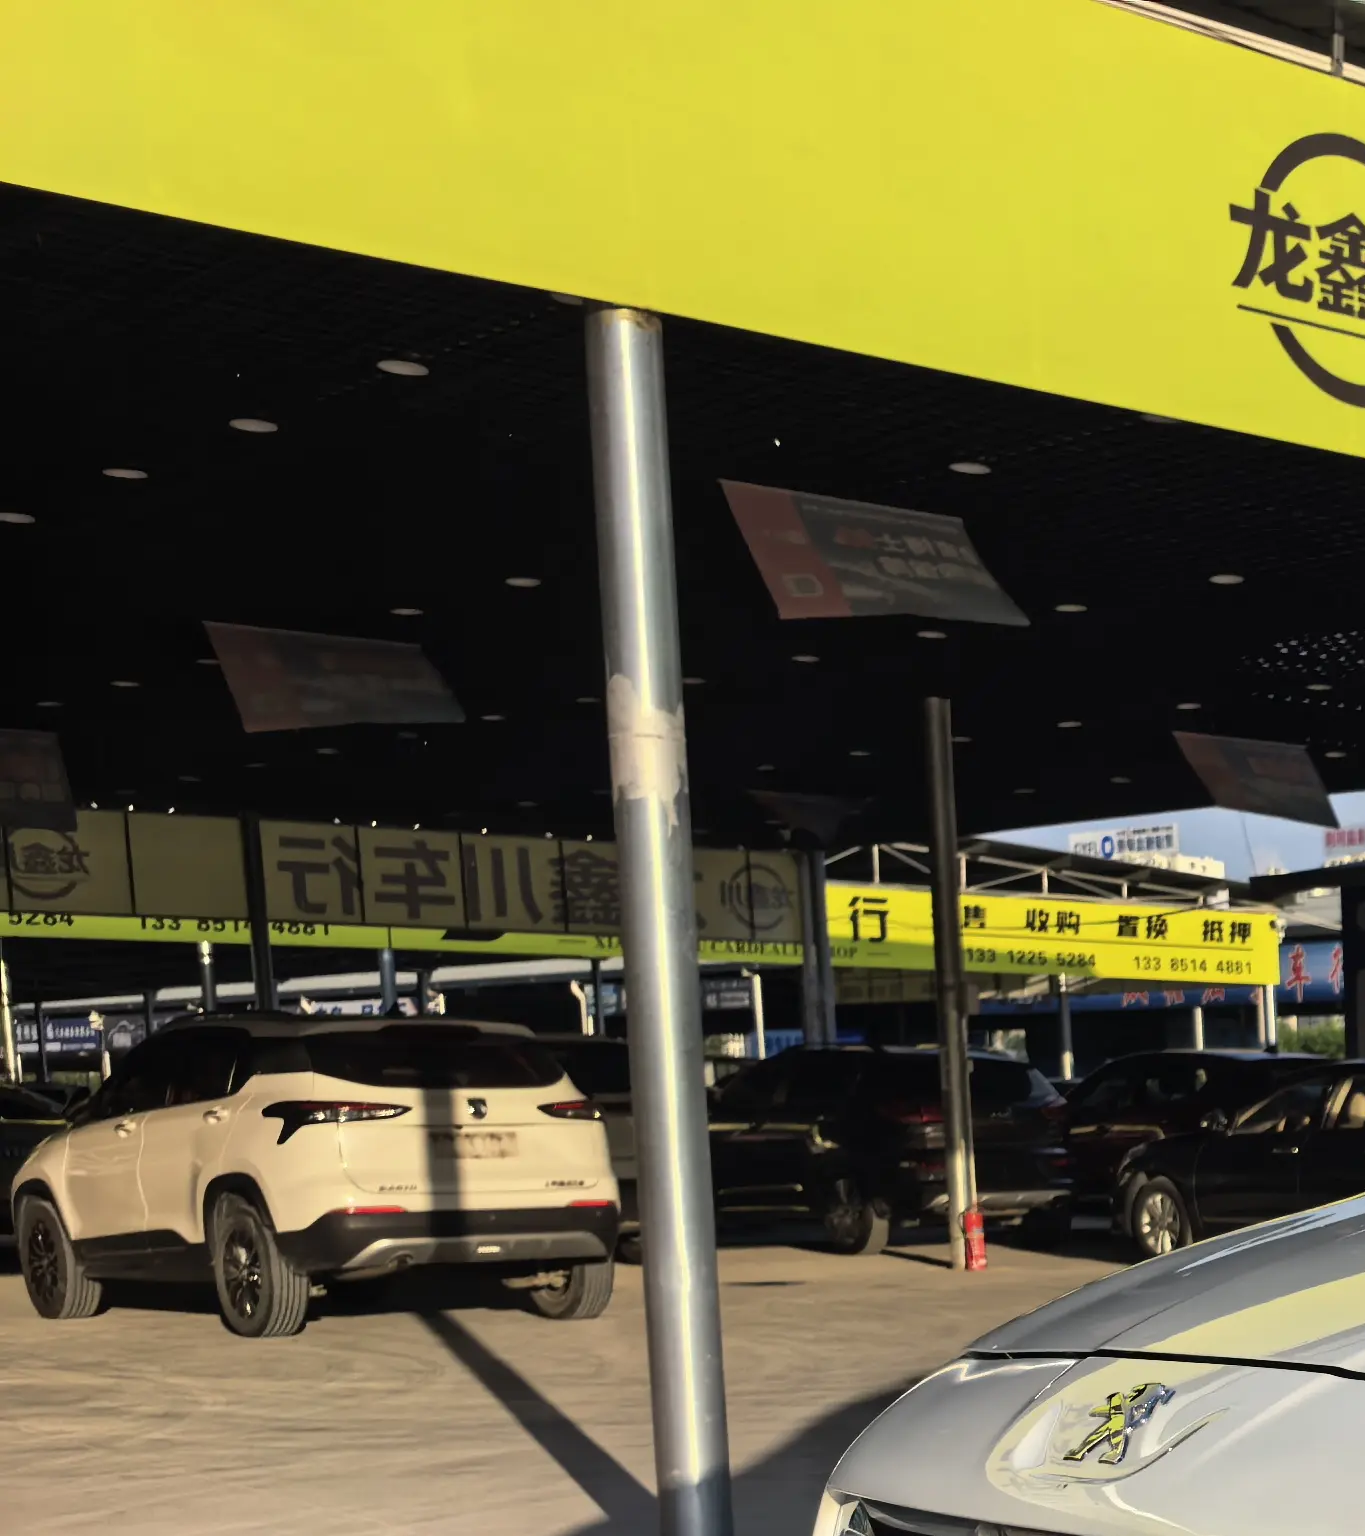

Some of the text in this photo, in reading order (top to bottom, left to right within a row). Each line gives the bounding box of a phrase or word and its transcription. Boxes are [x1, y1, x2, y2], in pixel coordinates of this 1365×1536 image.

[849, 896, 889, 943] 行
[1025, 908, 1081, 935] 收购
[1202, 919, 1252, 944] 抵押
[1133, 956, 1162, 971] 133
[1170, 958, 1208, 973] 8514
